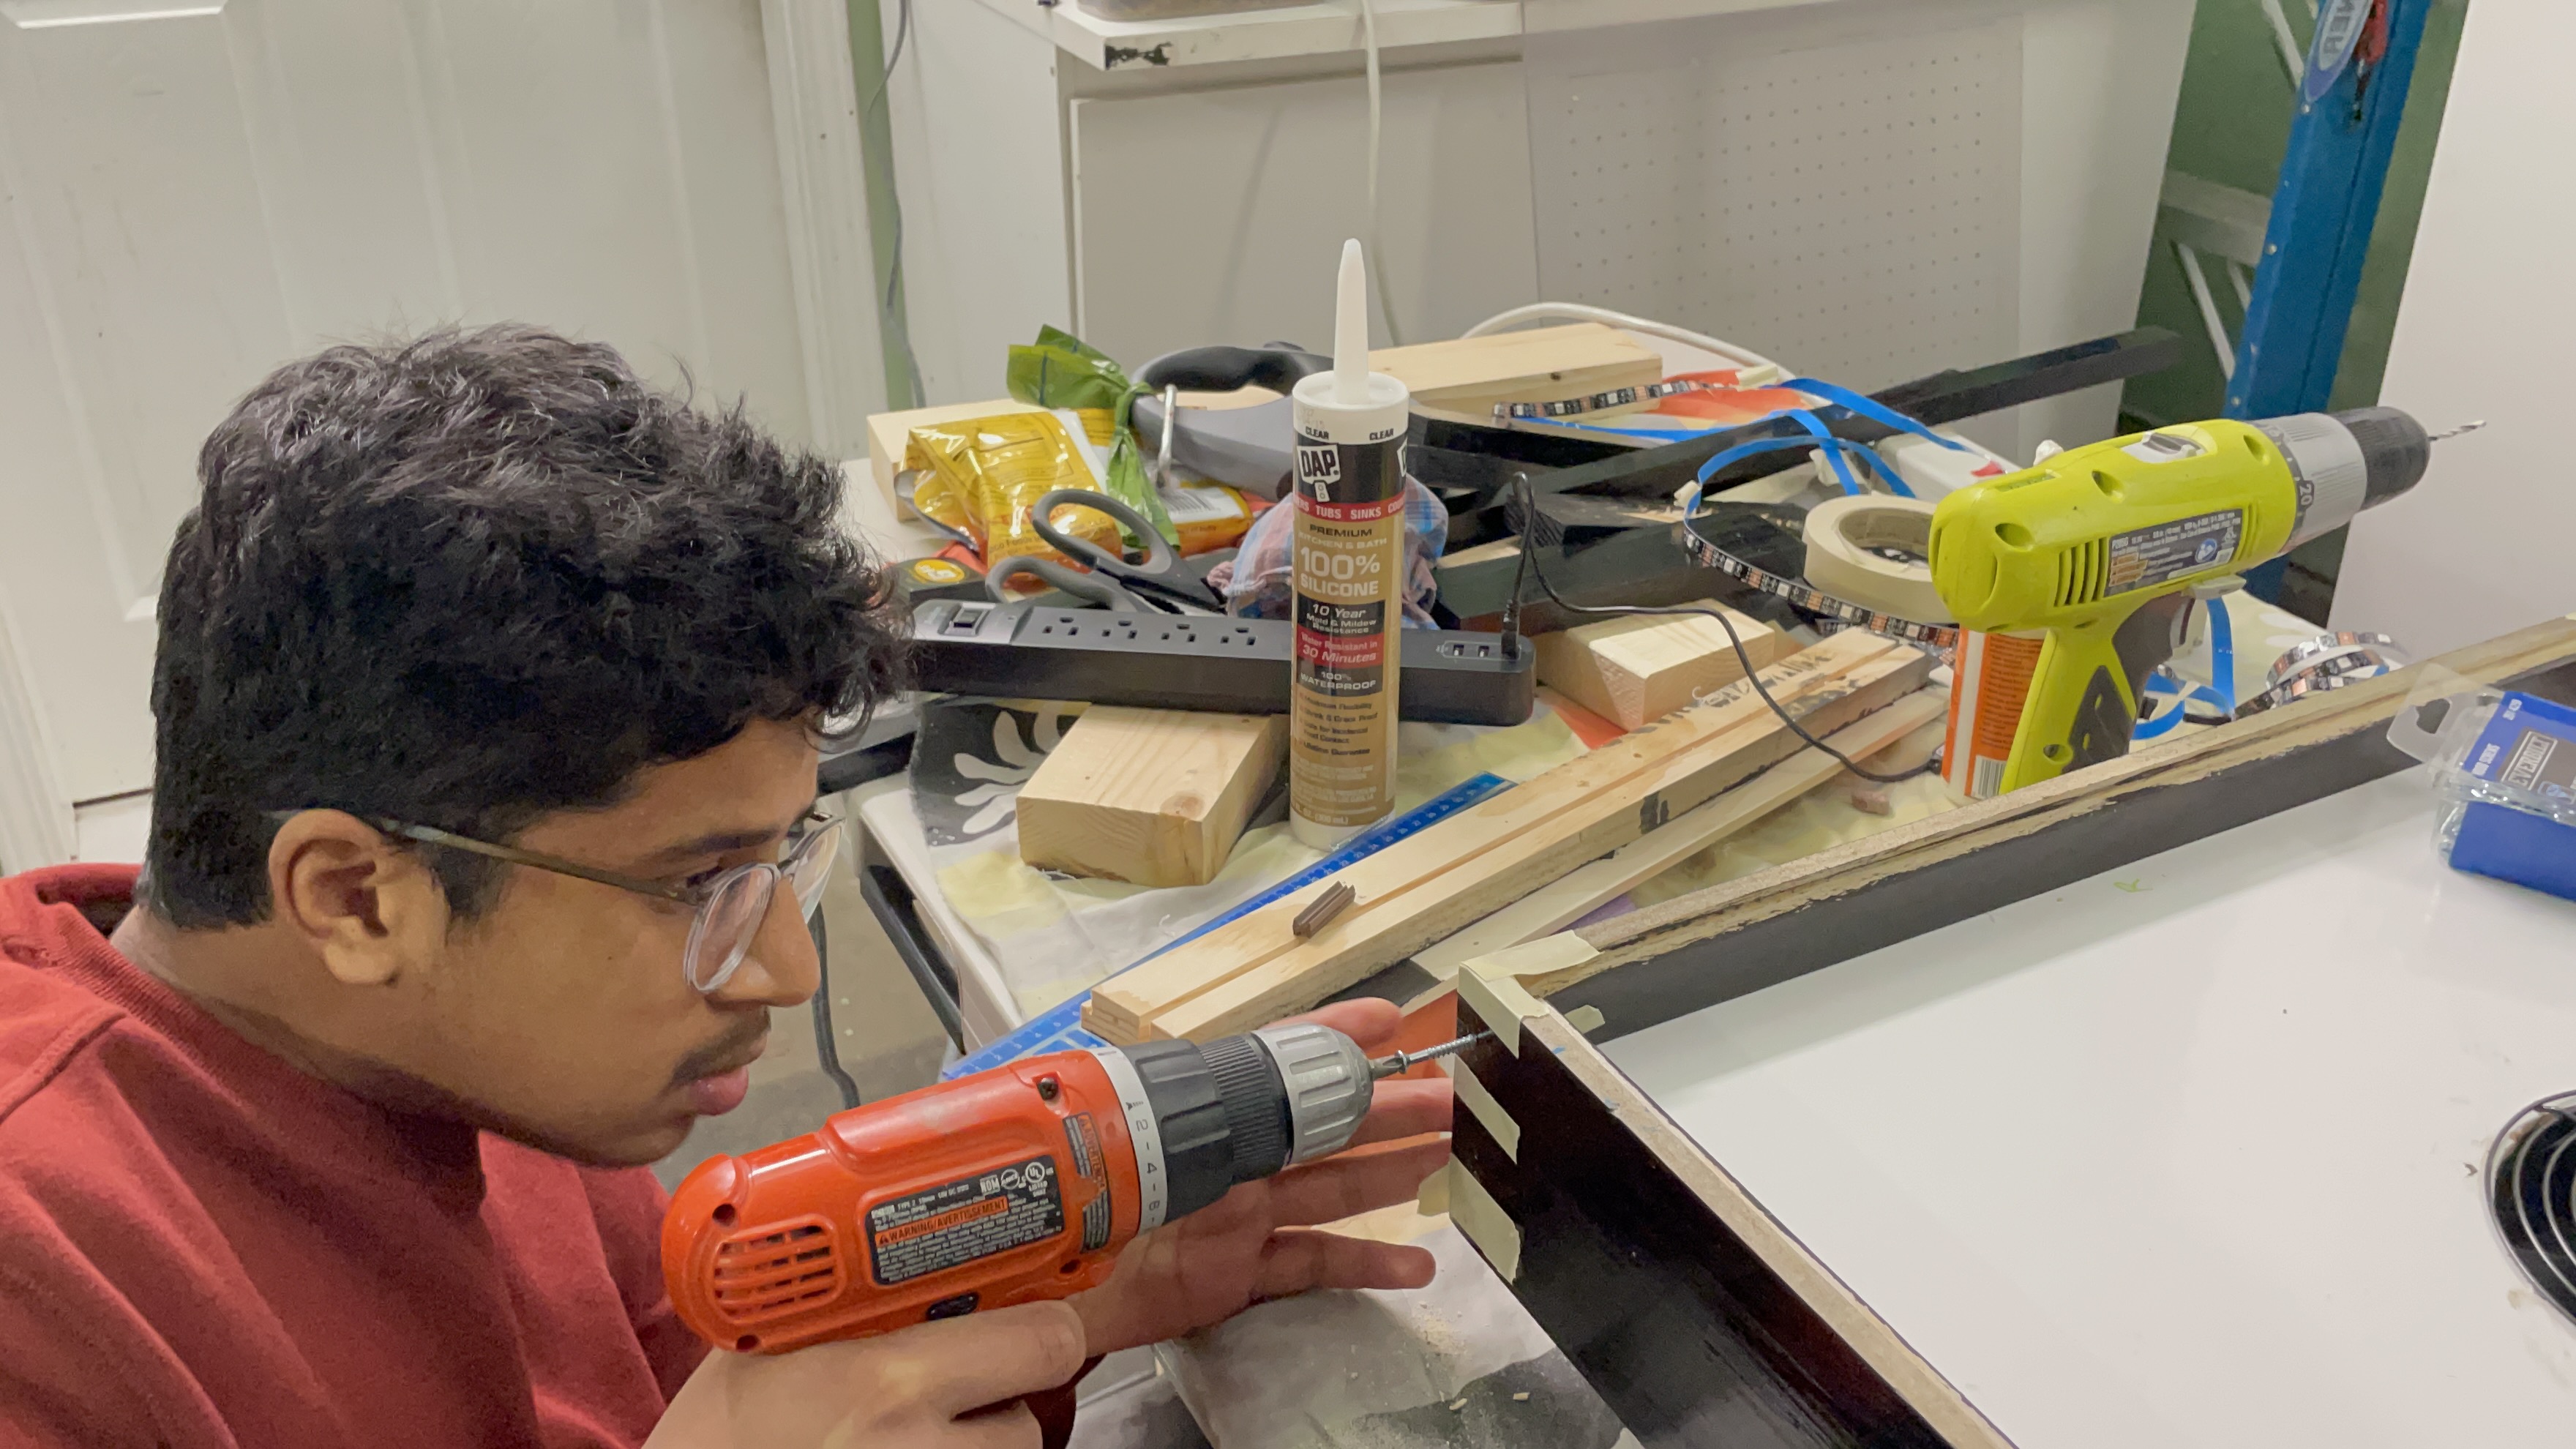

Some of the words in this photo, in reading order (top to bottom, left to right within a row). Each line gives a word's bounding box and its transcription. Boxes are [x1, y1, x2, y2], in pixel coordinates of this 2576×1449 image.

[1305, 426, 1330, 441] CLEAR
[1369, 427, 1394, 441] CLEAR
[2299, 483, 2313, 506] 20
[1315, 505, 1341, 520] TUBS
[1350, 506, 1382, 520] SINKS
[1309, 523, 1373, 537] PREMIUM
[1298, 531, 1344, 549] KITCHEN
[1357, 538, 1388, 550] BATH
[1300, 546, 1381, 580] 100%
[1300, 572, 1379, 598] SILICONE
[1312, 603, 1330, 616] 10
[1335, 608, 1367, 619] Year
[1306, 613, 1329, 626] Mold
[1341, 619, 1377, 627] Mildew
[1312, 624, 1370, 634] Resistance
[1301, 632, 1322, 648] Water
[1325, 639, 1368, 651] Resistant
[1369, 640, 1378, 648] in
[1303, 643, 1319, 659] 30
[1322, 651, 1377, 664] Minutes
[1300, 672, 1377, 691] WATERPROOF
[1320, 671, 1352, 681] 100%
[1136, 1118, 1149, 1133] 2
[1147, 1162, 1158, 1175] 4
